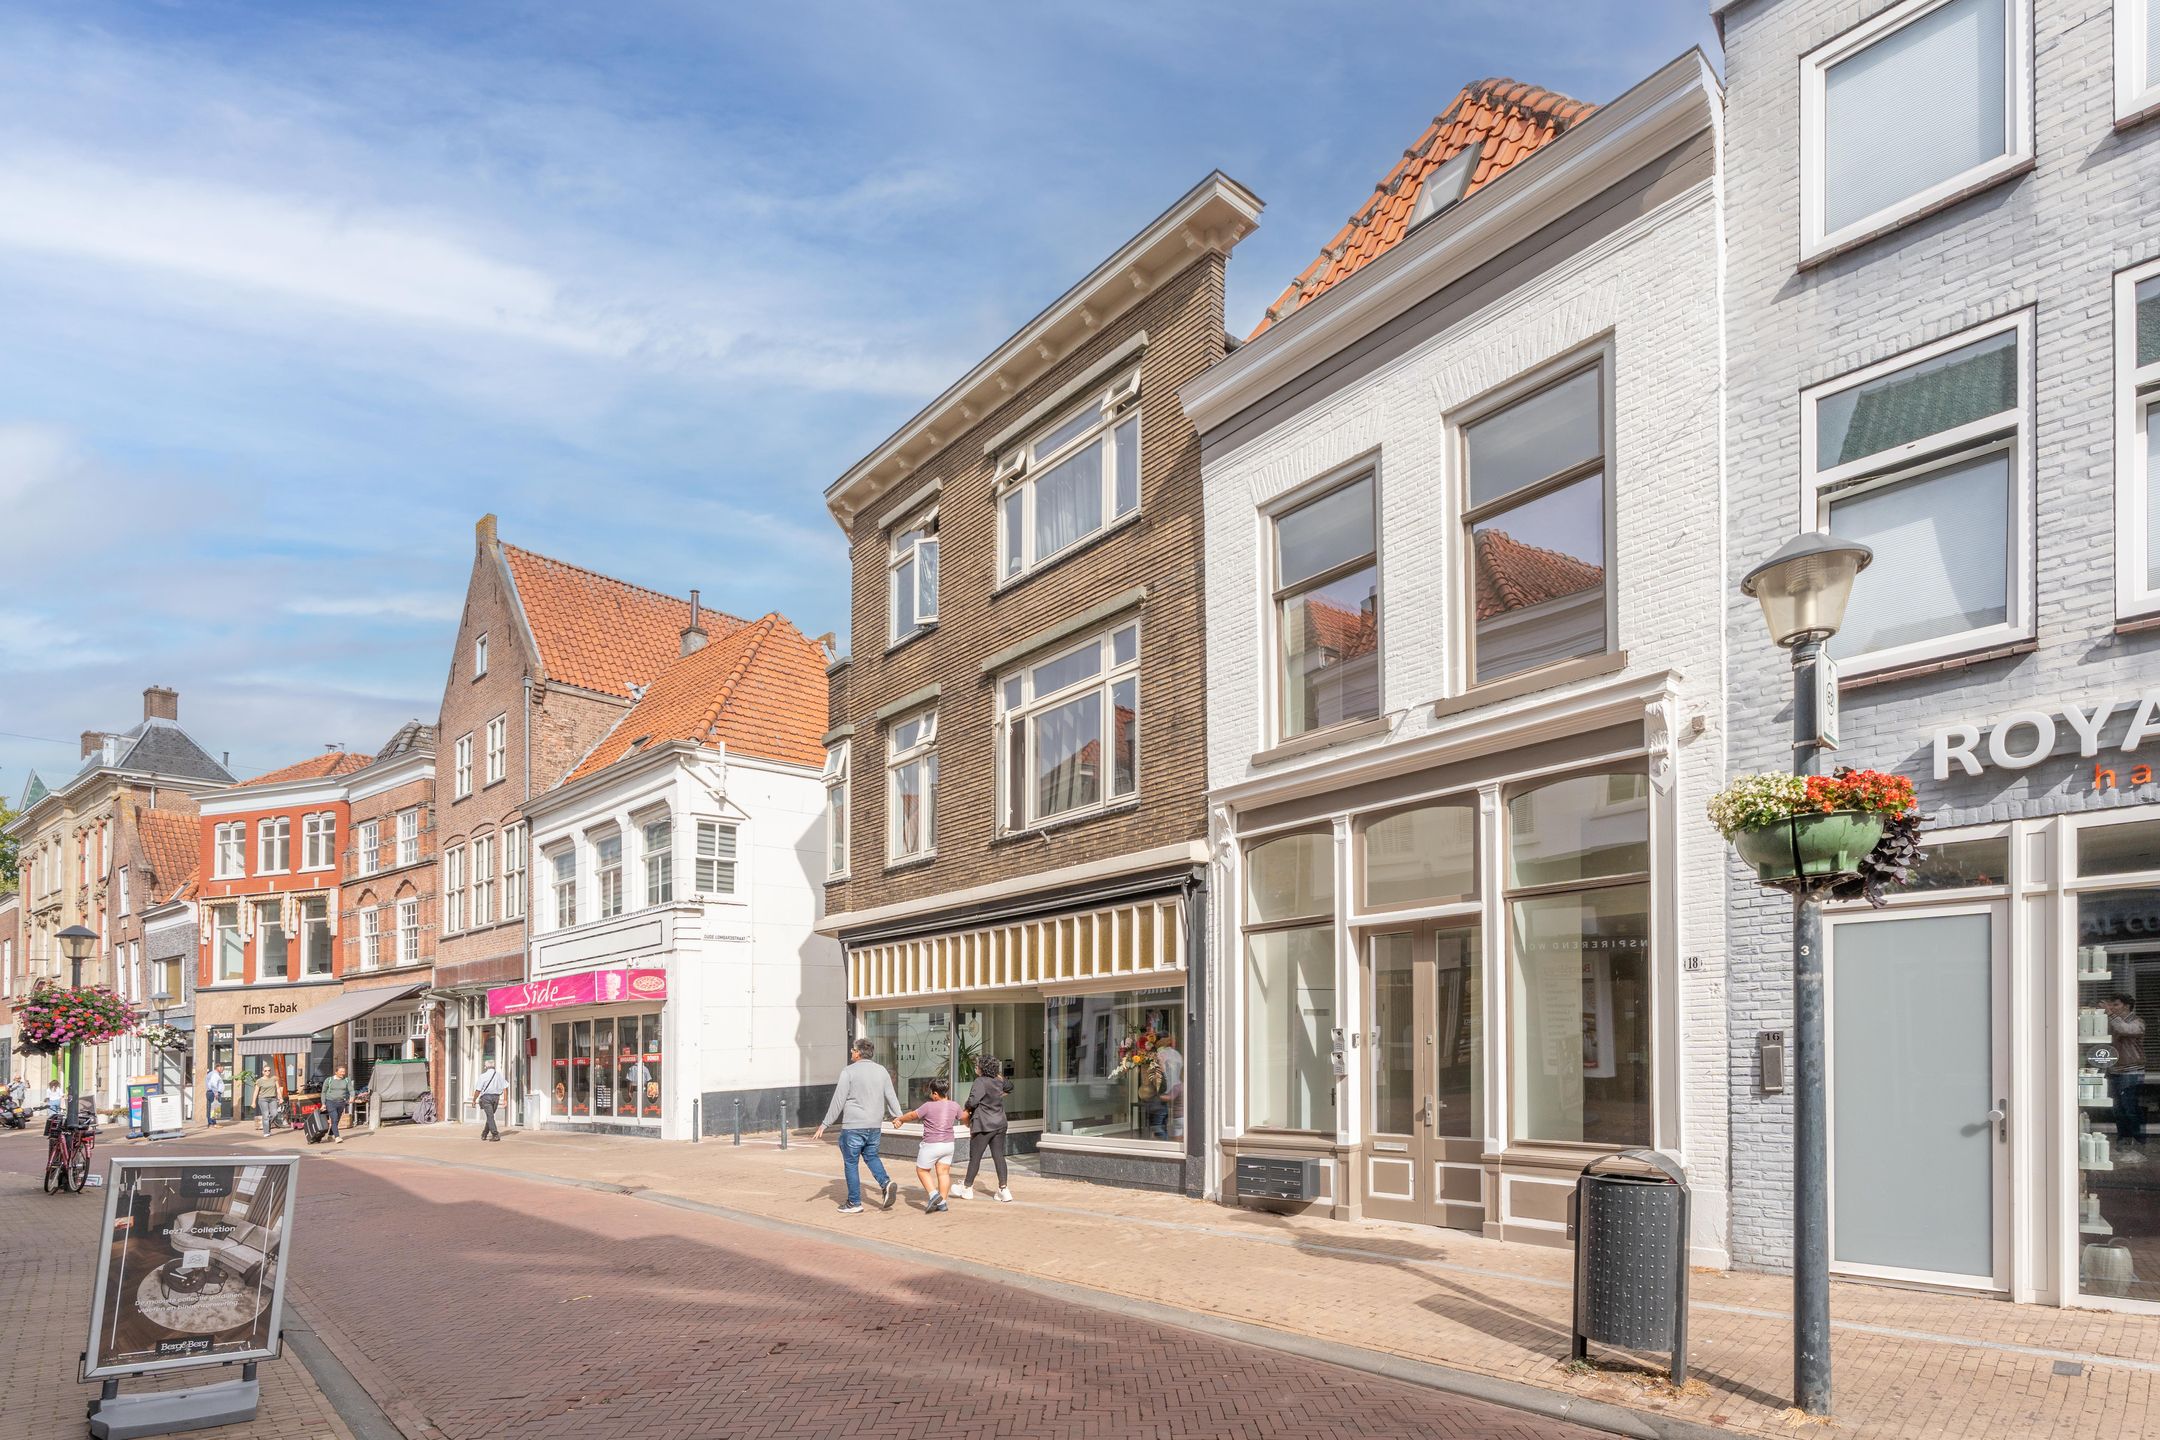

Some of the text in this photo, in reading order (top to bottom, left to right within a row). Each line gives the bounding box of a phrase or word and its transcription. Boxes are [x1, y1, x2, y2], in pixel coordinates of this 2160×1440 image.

[1933, 689, 2160, 780] ROYA
[1800, 945, 1810, 956] 3
[1687, 956, 1698, 969] 18
[242, 1002, 298, 1015] Tims Tabak
[1764, 1032, 1780, 1041] 16
[190, 1225, 236, 1234] Collection
[161, 1340, 209, 1352] Berg&Berg
